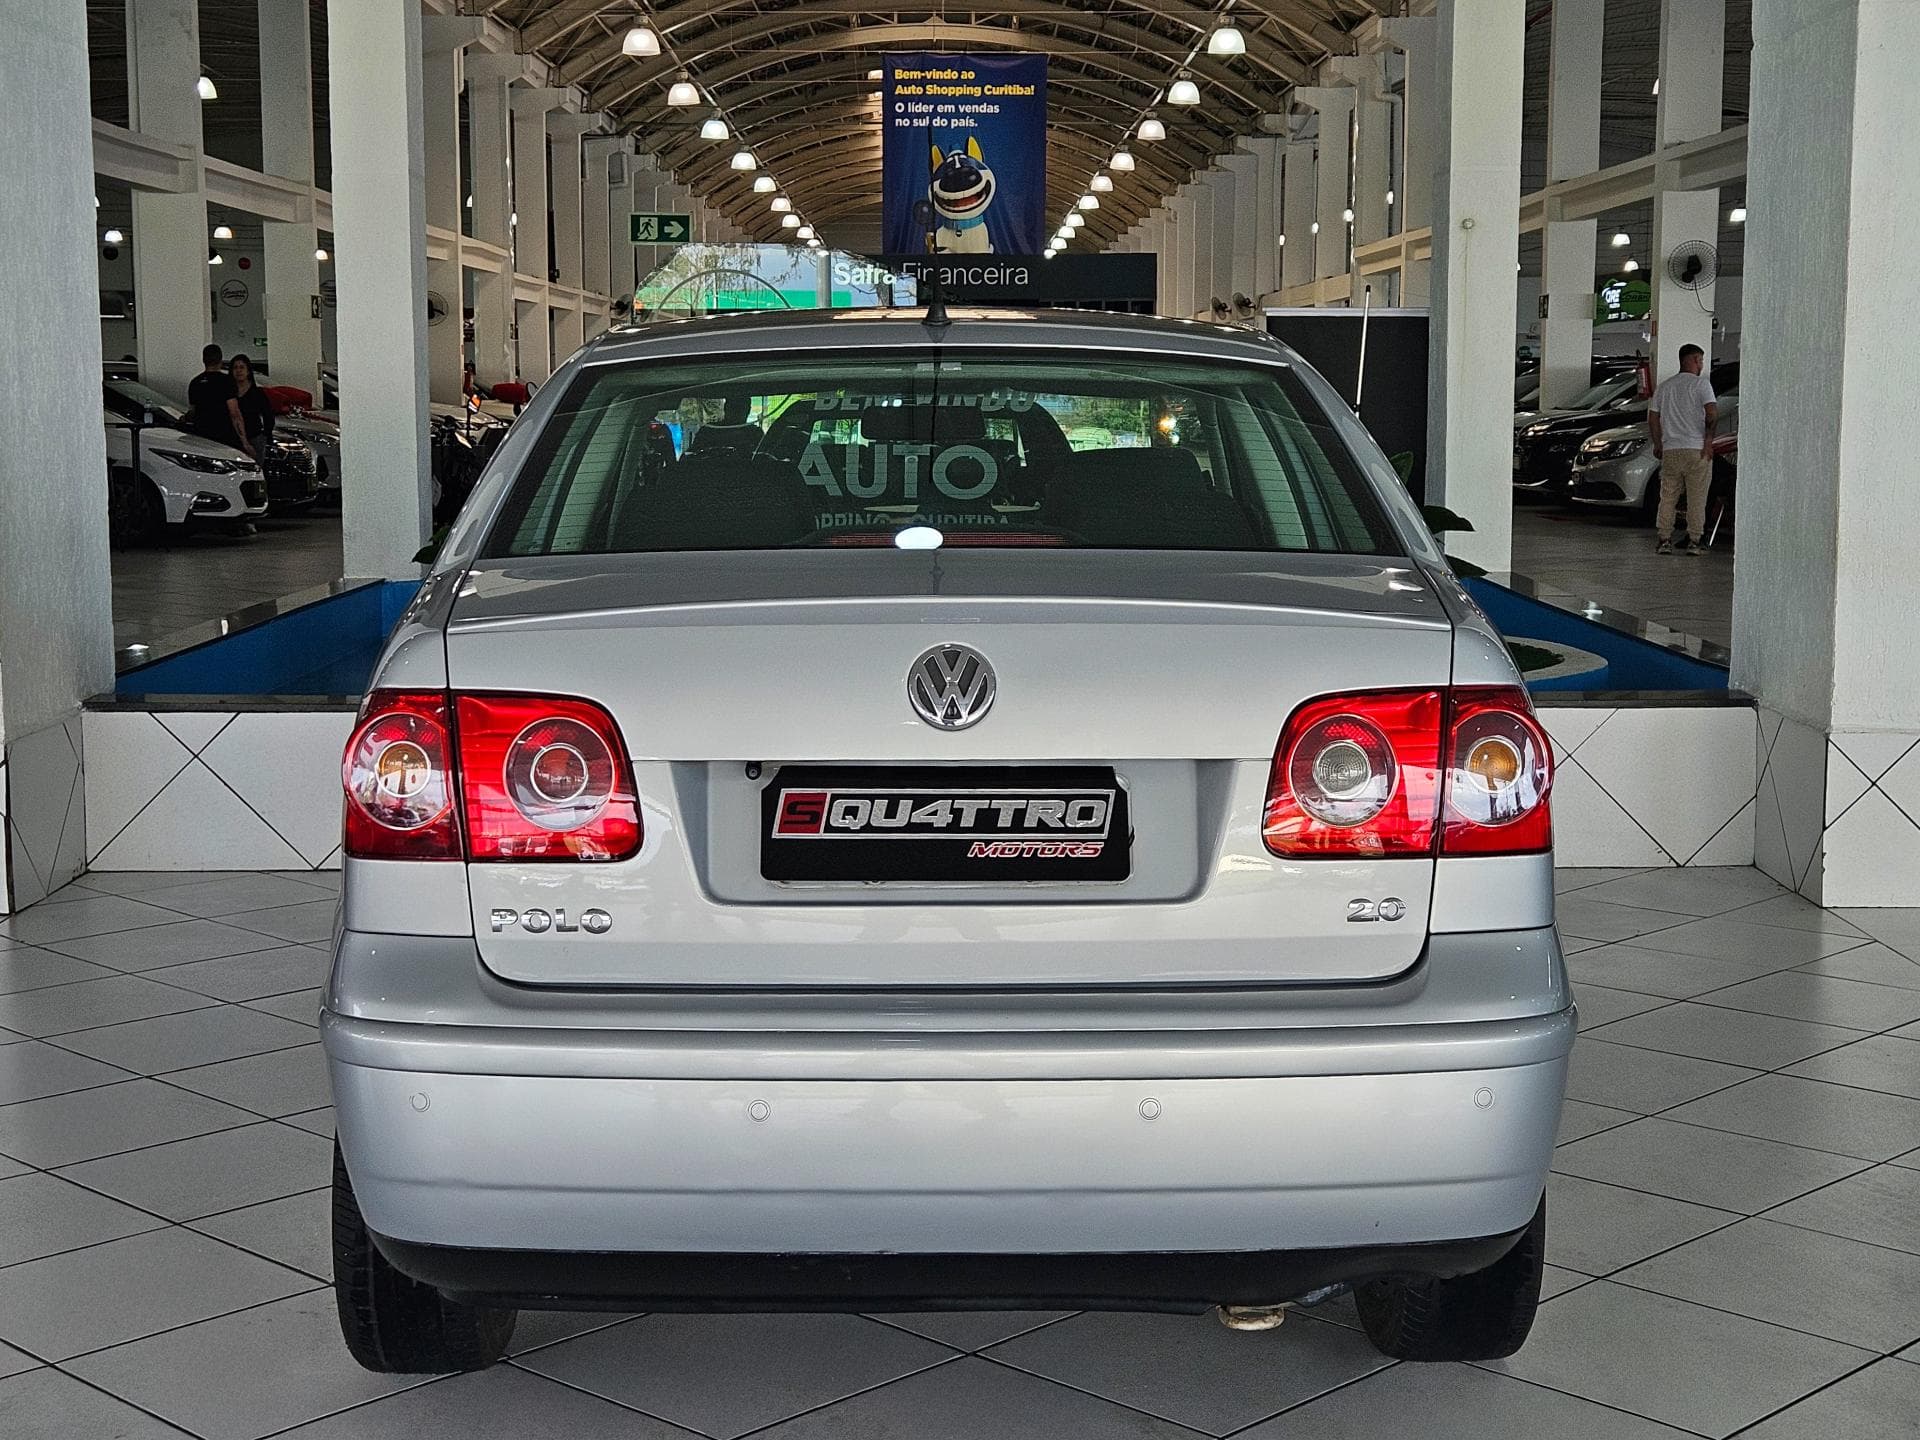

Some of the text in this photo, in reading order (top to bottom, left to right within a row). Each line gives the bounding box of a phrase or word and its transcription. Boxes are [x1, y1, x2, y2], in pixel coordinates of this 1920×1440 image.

[894, 69, 976, 80] Bem-vindo ao
[894, 84, 1035, 97] Auto Shopping Curitiba!
[894, 102, 1000, 114] O líder em vendas
[894, 115, 978, 129] no sul do país.
[798, 442, 998, 500] AUTO
[967, 841, 1105, 858] MOTORS
[1346, 897, 1407, 923] 2.0
[490, 907, 614, 935] POLO
